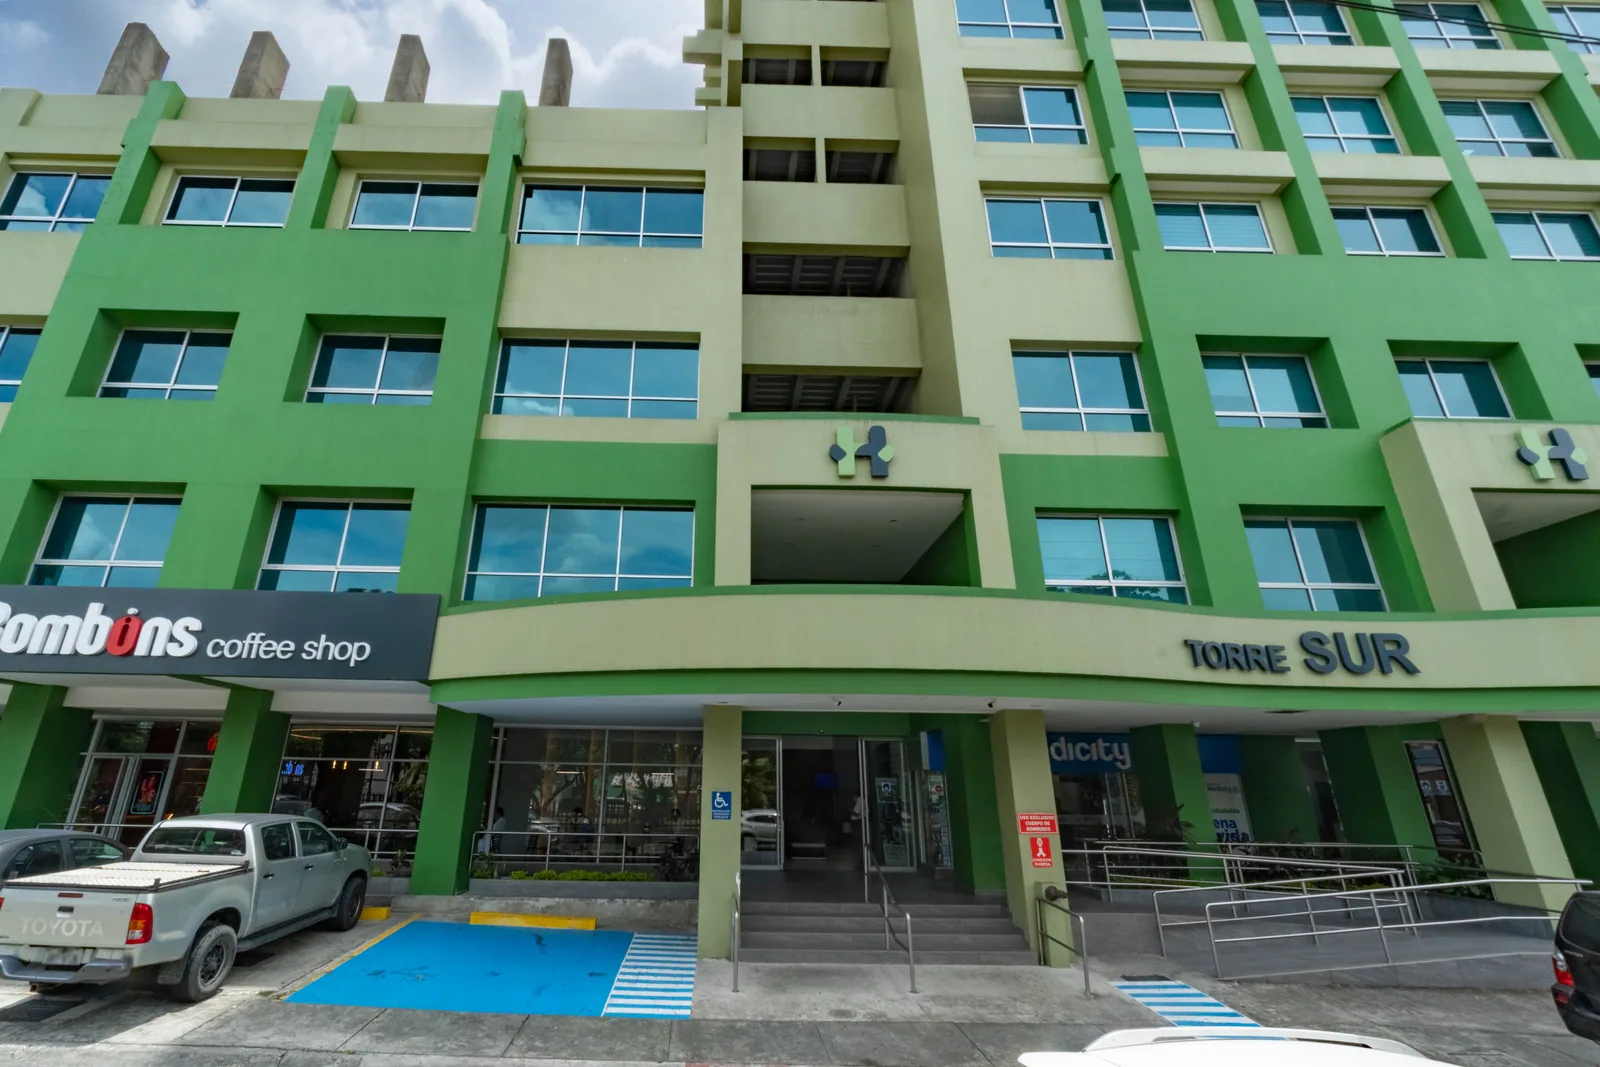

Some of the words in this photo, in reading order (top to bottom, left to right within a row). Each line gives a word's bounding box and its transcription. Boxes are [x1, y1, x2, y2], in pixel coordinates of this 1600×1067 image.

[206, 632, 295, 660] coffee
[301, 634, 371, 667] shop
[1184, 639, 1291, 673] TORRE
[1299, 630, 1421, 675] SUR
[1050, 736, 1131, 770] dicity
[1213, 819, 1237, 828] ena
[21, 917, 104, 938] TOYOTA
